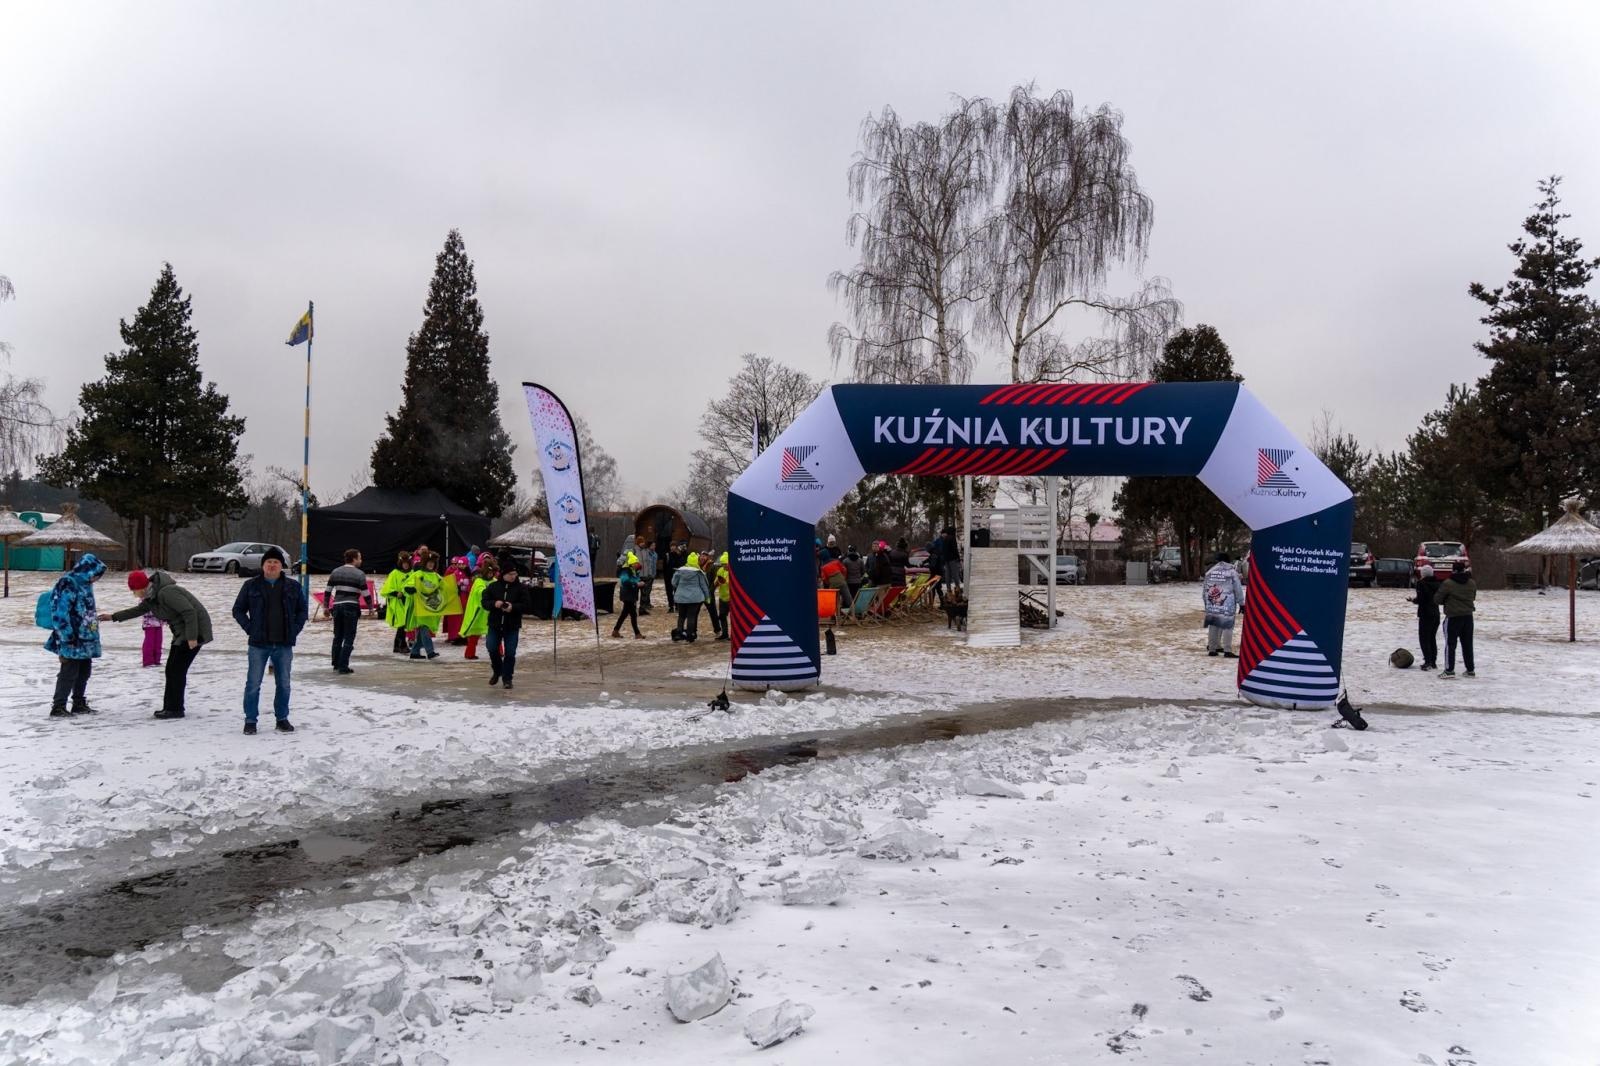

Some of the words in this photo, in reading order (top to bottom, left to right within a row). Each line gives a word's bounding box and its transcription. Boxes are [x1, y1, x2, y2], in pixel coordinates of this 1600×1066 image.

[874, 408, 1010, 444] KUŹNIA
[1020, 416, 1193, 445] KULTURY
[1272, 546, 1295, 554] Miejski
[1295, 547, 1324, 556] Ośrodek
[1325, 549, 1344, 558] Kultury
[756, 554, 793, 562] Raciborskiej
[1279, 555, 1302, 563] Sportu
[1306, 557, 1336, 566] Rekreacji
[1301, 565, 1338, 575] Raciborskiej
